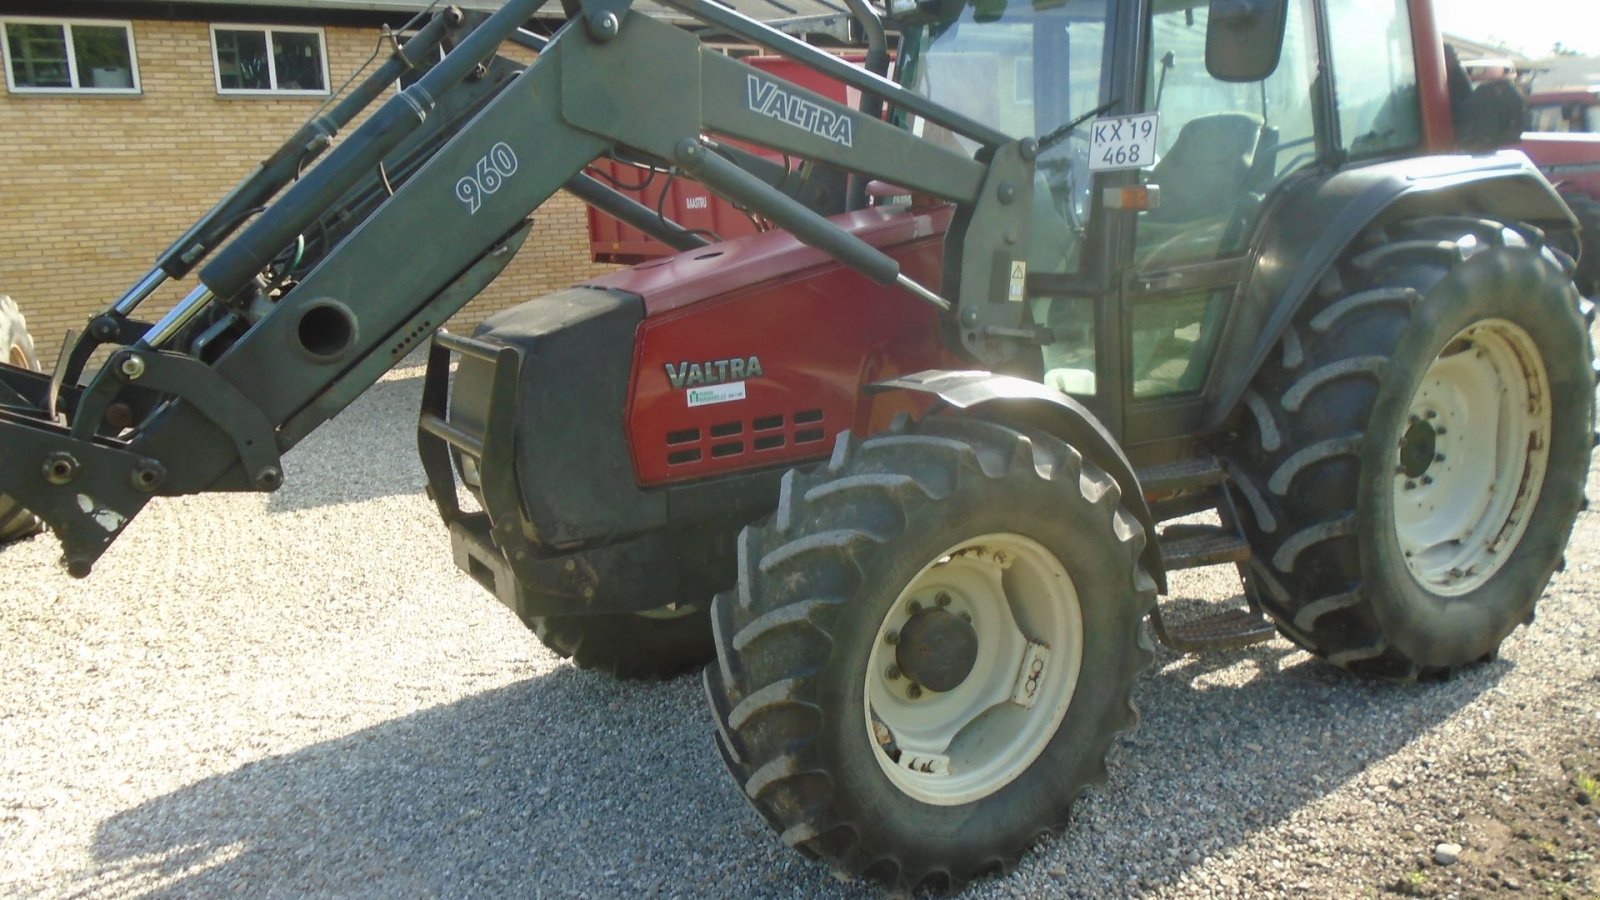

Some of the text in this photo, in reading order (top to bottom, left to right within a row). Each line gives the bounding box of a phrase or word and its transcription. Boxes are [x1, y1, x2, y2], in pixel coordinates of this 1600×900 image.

[747, 73, 852, 148] VALTRA
[456, 141, 518, 215] 960
[1102, 144, 1139, 165] 468
[664, 355, 763, 388] VALTRA
